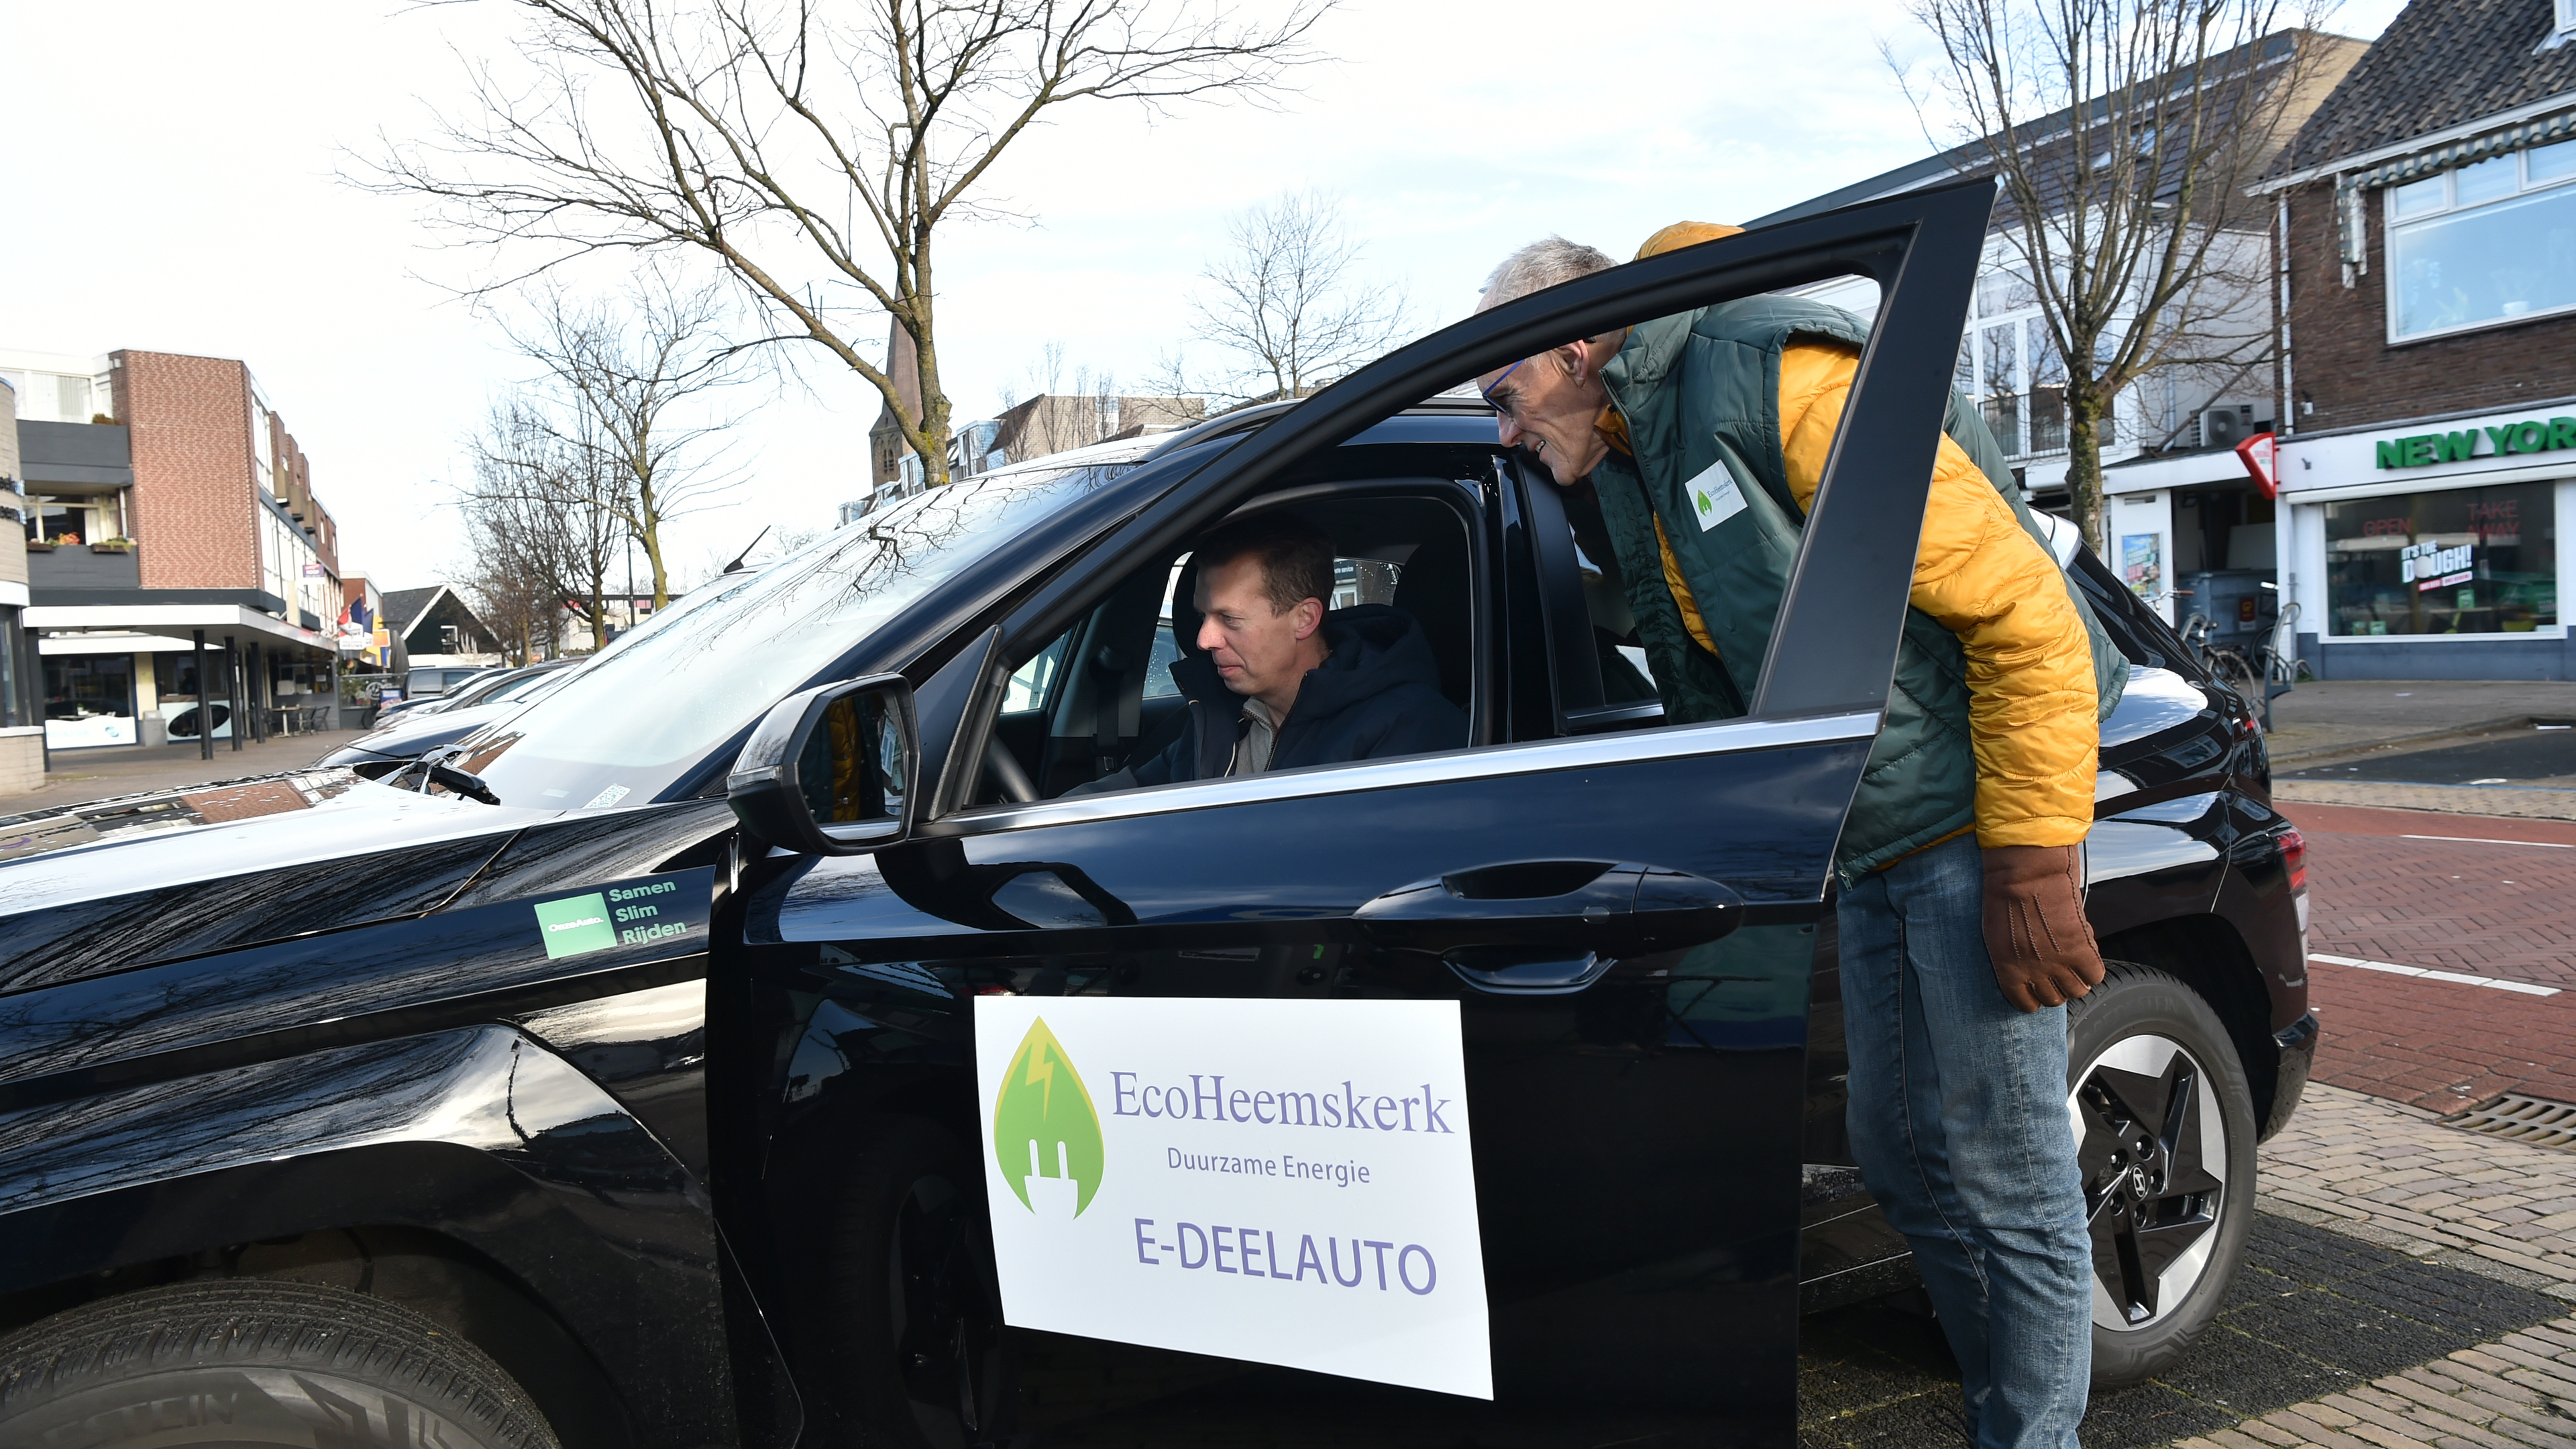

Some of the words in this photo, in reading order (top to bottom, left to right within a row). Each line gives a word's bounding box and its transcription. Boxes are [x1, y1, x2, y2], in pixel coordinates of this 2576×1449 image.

[2376, 429, 2478, 469] NEW
[2484, 416, 2576, 456] YOR
[1707, 478, 1733, 498] EcoHeemskerk
[2467, 500, 2519, 521] TAKE
[2363, 517, 2412, 537] OPEN
[2467, 521, 2520, 541] AWAY
[2420, 539, 2438, 555] THE
[608, 881, 676, 902] Samen
[615, 905, 658, 922] Slim
[622, 922, 688, 945] Rijden
[1110, 1071, 1455, 1134] EcoHeemskerk
[1167, 1146, 1276, 1176] Duurzame
[1283, 1155, 1371, 1188] Energie
[1134, 1218, 1437, 1296] E-DEELAUTO
